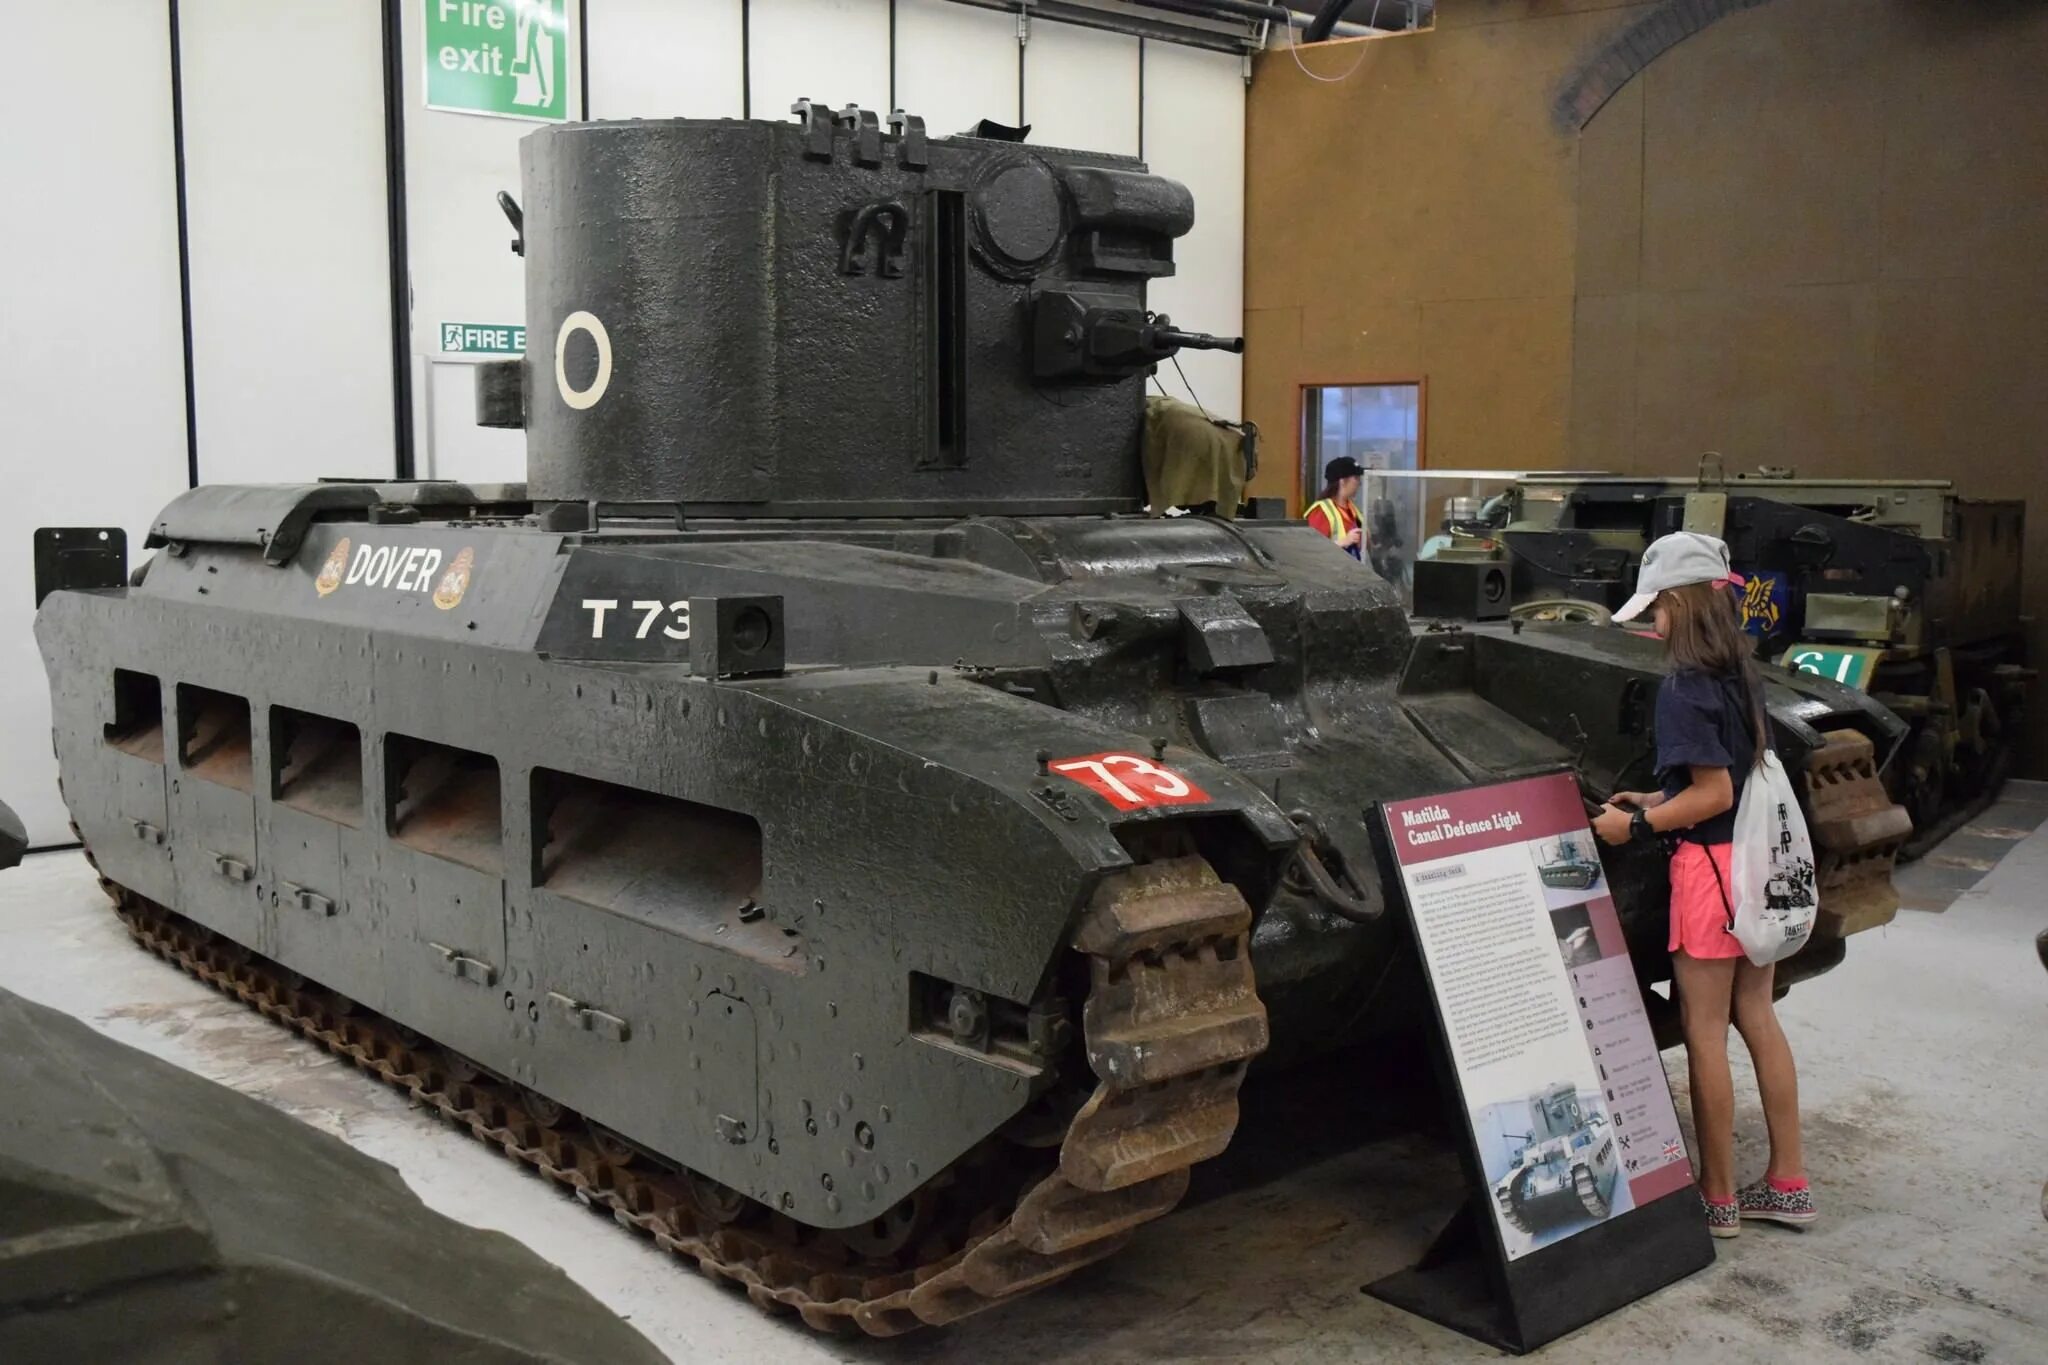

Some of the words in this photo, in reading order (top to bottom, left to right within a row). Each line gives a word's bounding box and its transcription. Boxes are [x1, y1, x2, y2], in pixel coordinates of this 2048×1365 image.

[439, 0, 506, 30] Fire
[439, 42, 504, 77] exit
[465, 328, 509, 350] FIRE
[345, 543, 443, 593] DOVER
[582, 599, 618, 639] T
[1054, 755, 1190, 803] 73
[1402, 805, 1450, 826] Matilda
[1408, 825, 1443, 845] Canal
[1443, 819, 1492, 839] Defence
[1491, 811, 1522, 831] Light
